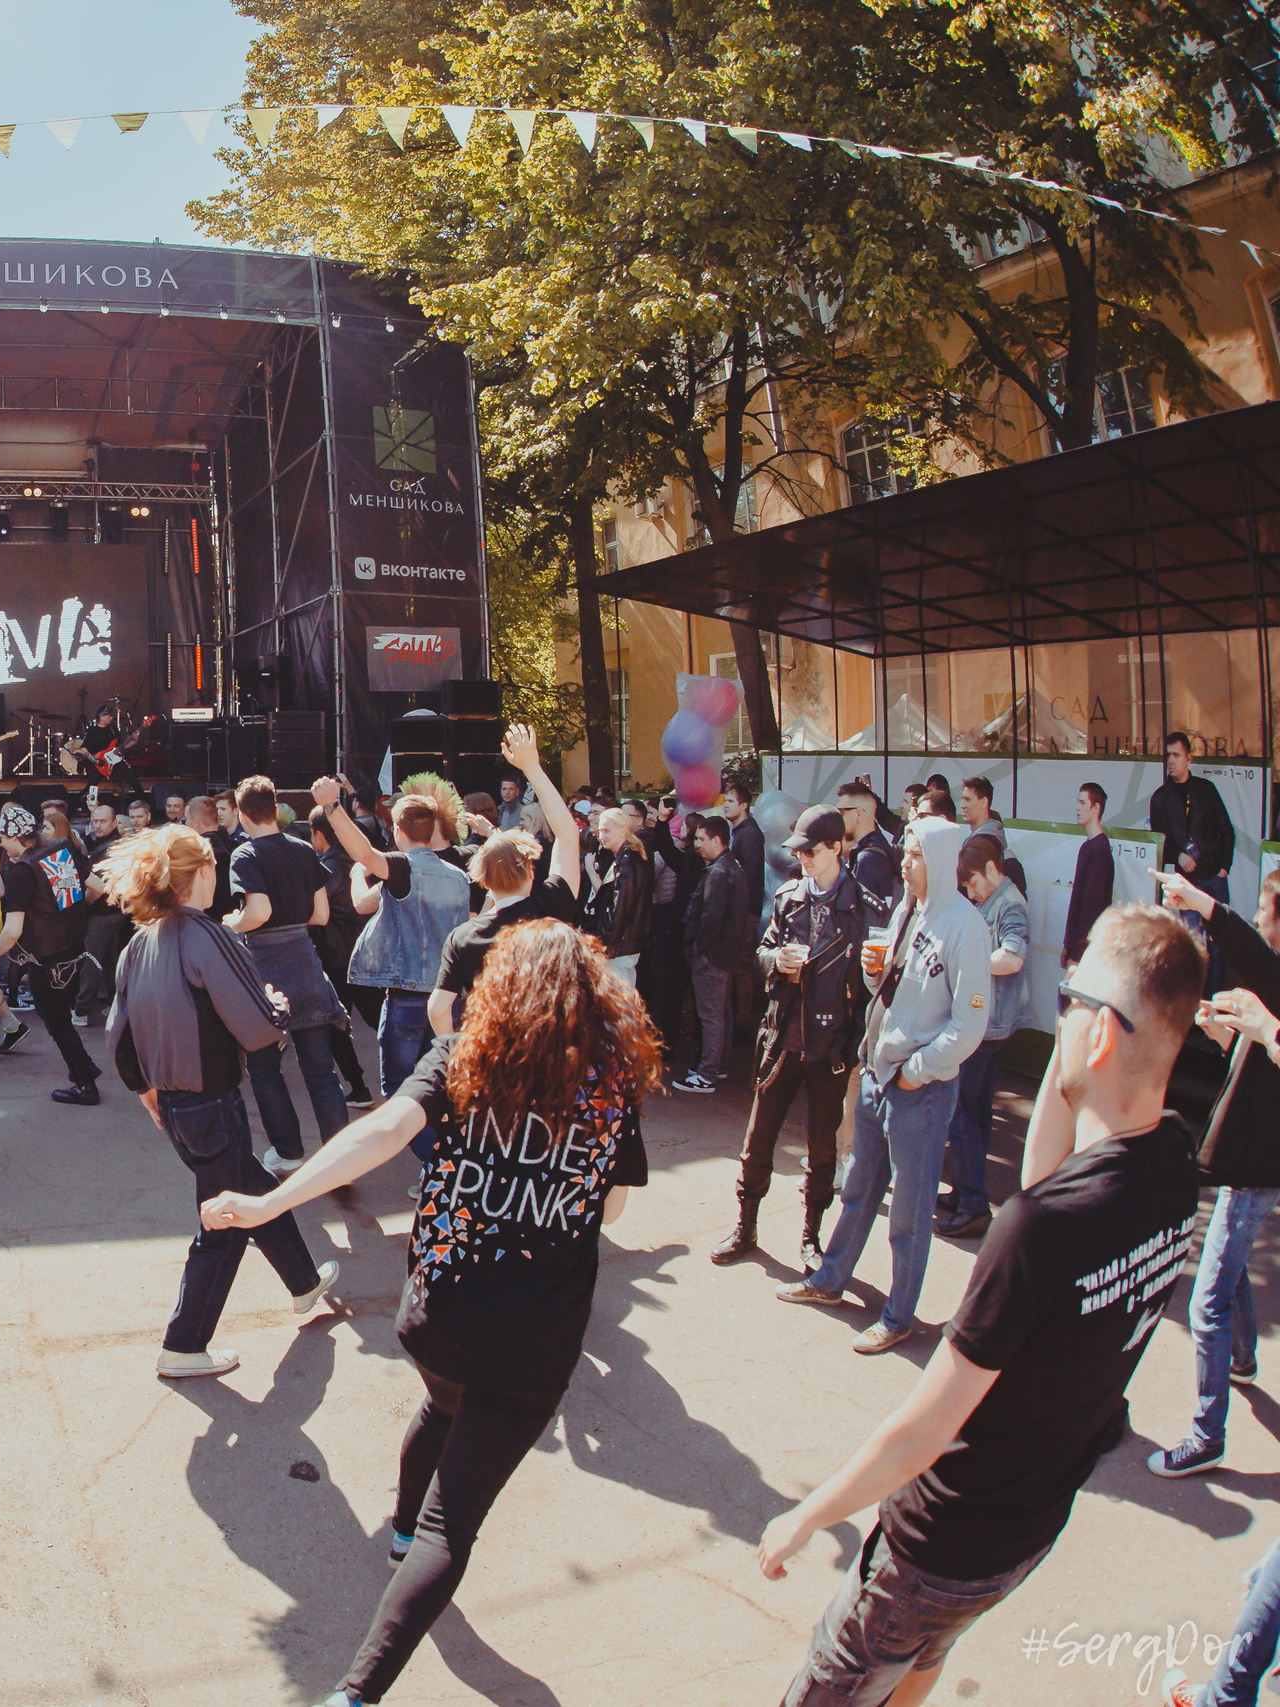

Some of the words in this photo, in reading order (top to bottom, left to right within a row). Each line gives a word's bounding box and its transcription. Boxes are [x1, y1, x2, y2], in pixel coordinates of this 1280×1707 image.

[389, 479, 425, 495] САД
[349, 493, 464, 514] МЕНШИКОВА
[1051, 696, 1108, 723] САД
[466, 1106, 591, 1175] INDIE
[450, 1159, 581, 1231] PUNK
